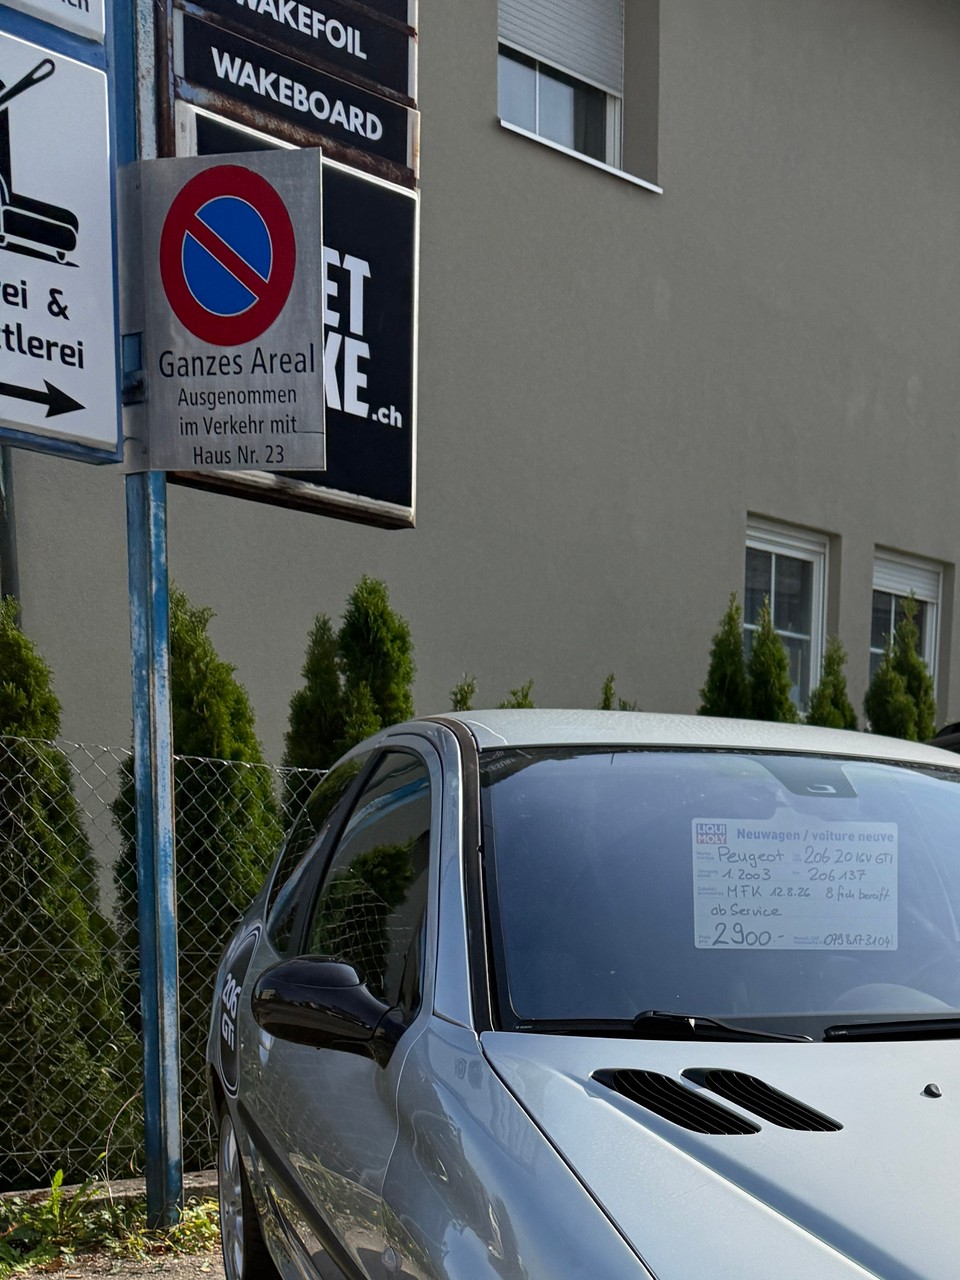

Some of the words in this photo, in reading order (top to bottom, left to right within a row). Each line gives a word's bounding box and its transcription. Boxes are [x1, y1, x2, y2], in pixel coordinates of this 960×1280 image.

[211, 46, 383, 141] WAKEBOARD
[0, 279, 28, 309] ei
[47, 287, 70, 321] &
[0, 322, 84, 369] tlerei
[158, 350, 243, 378] Ganzes
[250, 343, 315, 374] Areal
[178, 388, 297, 411] Ausgenommen
[180, 417, 198, 436] im
[202, 415, 264, 435] Verkehr
[270, 414, 297, 434] mit
[193, 446, 232, 465] Haus
[237, 445, 259, 464] Nr.
[265, 445, 284, 464] 23
[697, 824, 726, 834] LIQUI
[697, 834, 727, 844] MOLY
[736, 828, 800, 842] Neuwagen
[812, 830, 855, 841] voiture
[858, 832, 895, 842] neuve
[717, 845, 785, 868] Peugeot
[803, 845, 831, 864] 206
[738, 868, 772, 880] 2003
[770, 886, 811, 898] 12.8.26
[825, 886, 834, 899] 8
[710, 903, 727, 916] ab
[730, 902, 783, 917] Service
[222, 972, 242, 1019] 206
